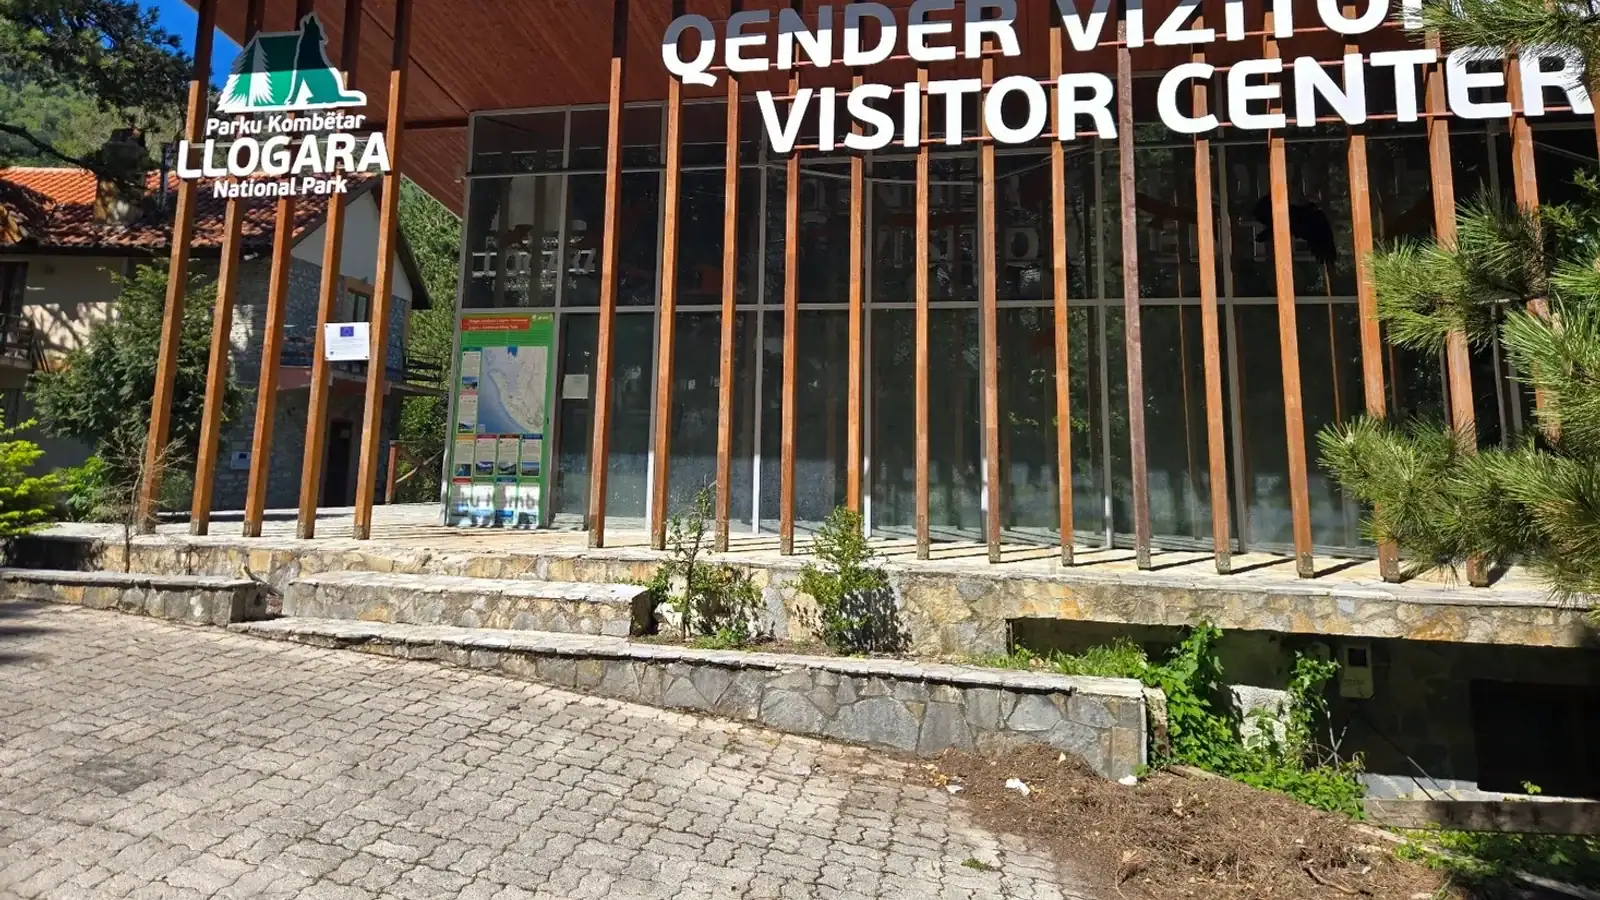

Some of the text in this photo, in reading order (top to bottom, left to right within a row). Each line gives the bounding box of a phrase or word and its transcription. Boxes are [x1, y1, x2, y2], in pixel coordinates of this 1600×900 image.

[662, 0, 1021, 87] QENDER
[756, 43, 1595, 153] VISITOR CENTER
[206, 113, 366, 136] Parku Kombëtar
[177, 132, 391, 178] LLOGARA
[213, 175, 348, 198] National Park
